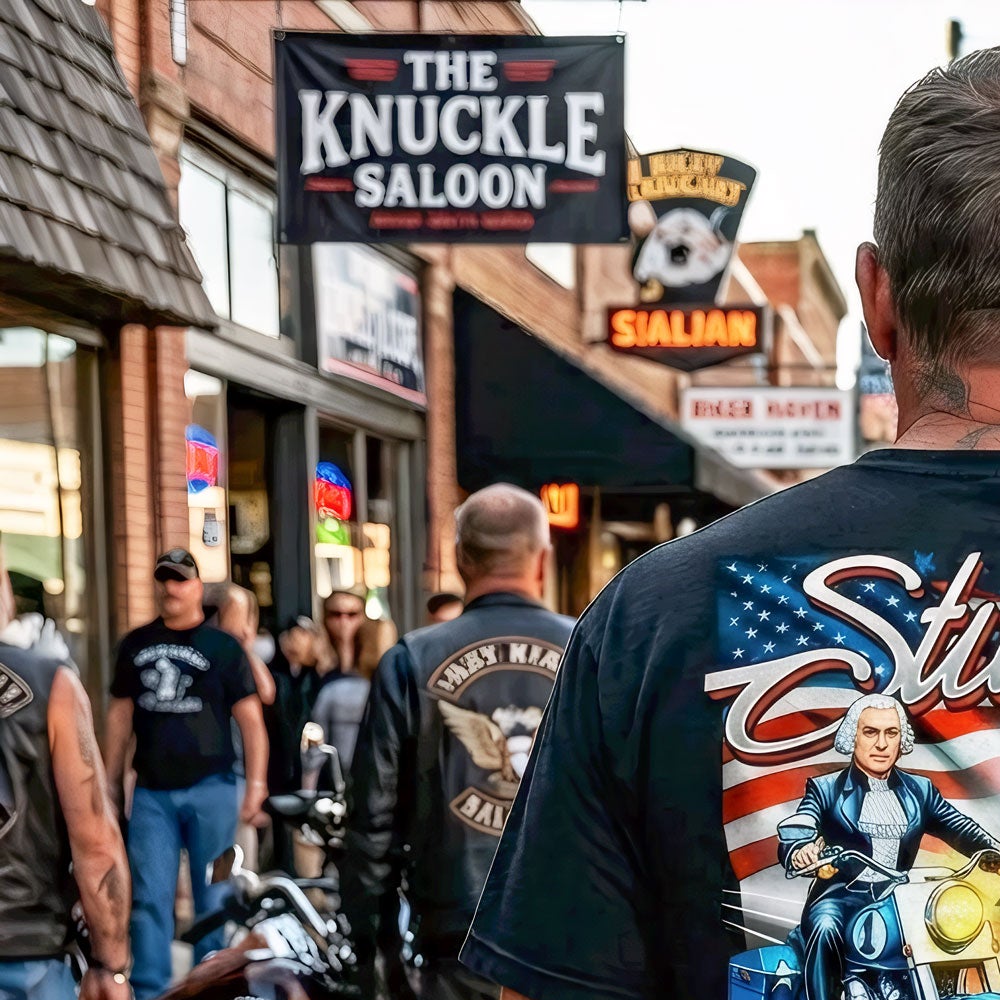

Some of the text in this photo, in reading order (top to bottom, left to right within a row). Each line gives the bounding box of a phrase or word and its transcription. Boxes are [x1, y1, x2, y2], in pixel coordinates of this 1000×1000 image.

[403, 50, 498, 91] THE
[298, 89, 606, 176] KNUCKLE
[353, 162, 547, 209] SALOON
